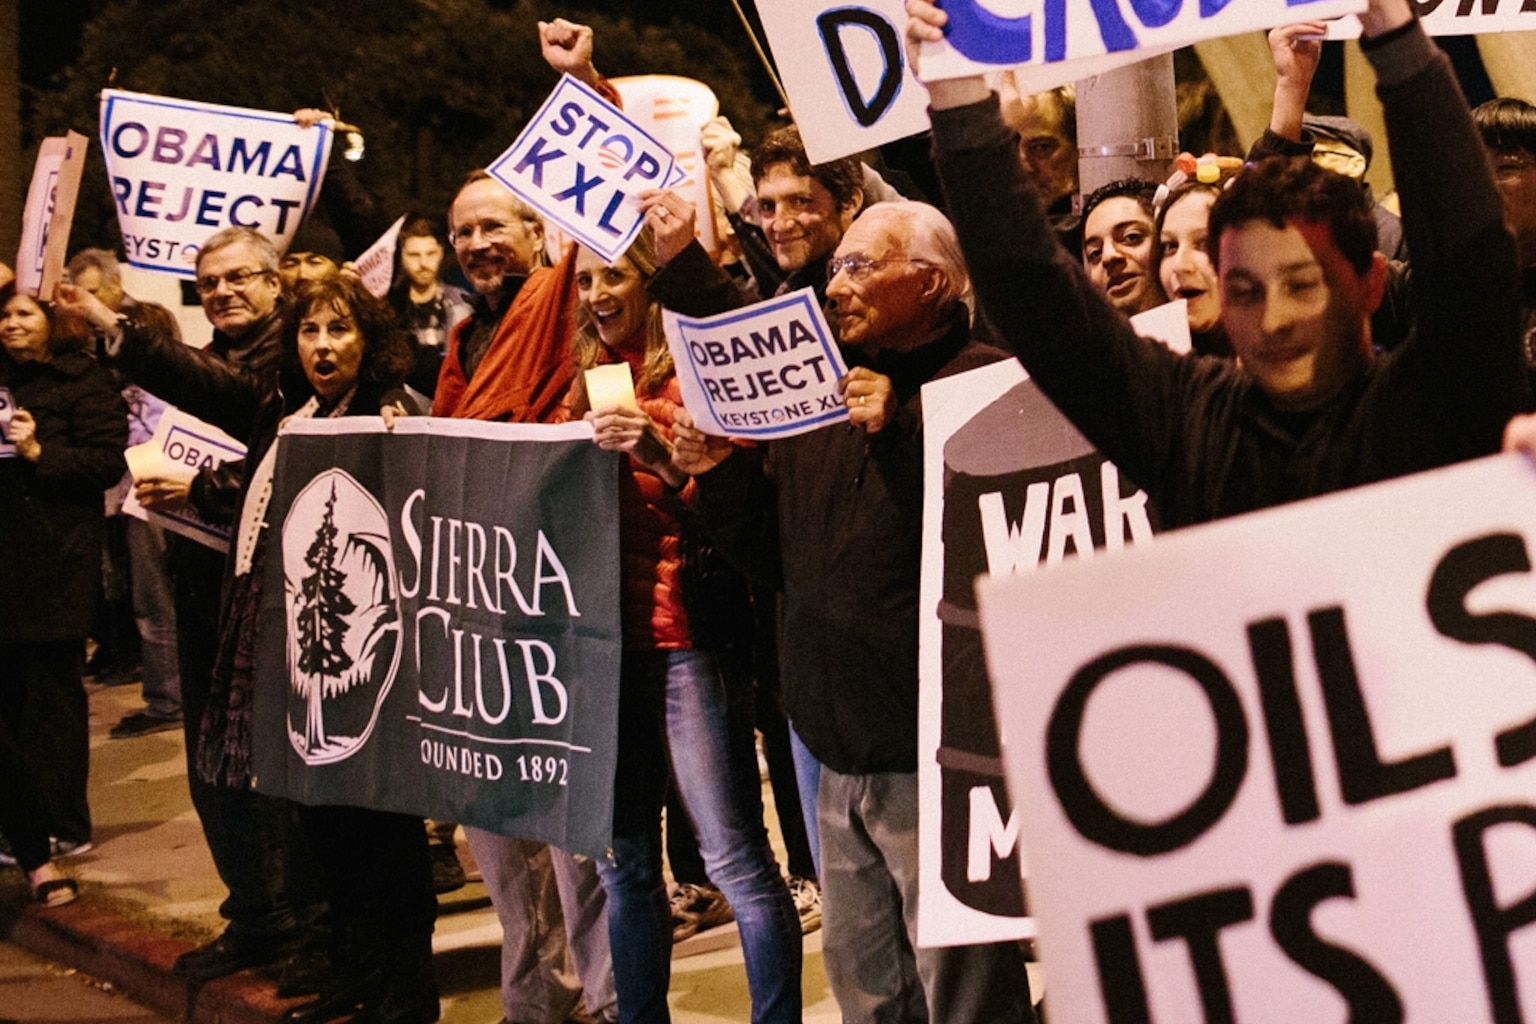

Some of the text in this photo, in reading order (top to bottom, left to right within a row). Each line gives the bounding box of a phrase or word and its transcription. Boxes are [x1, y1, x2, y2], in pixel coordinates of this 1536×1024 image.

[111, 121, 306, 184] OBAMA
[550, 101, 660, 181] STOP
[113, 176, 301, 235] REJECT
[513, 136, 624, 239] KXL
[690, 319, 816, 367] OBAMA
[703, 355, 826, 403] REJECT
[719, 393, 844, 427] KEYSTONE XL
[400, 488, 581, 617] SIERRA
[416, 606, 569, 726] CLUB
[420, 738, 569, 786] OUNDED 1892
[1045, 605, 1458, 859] OIL
